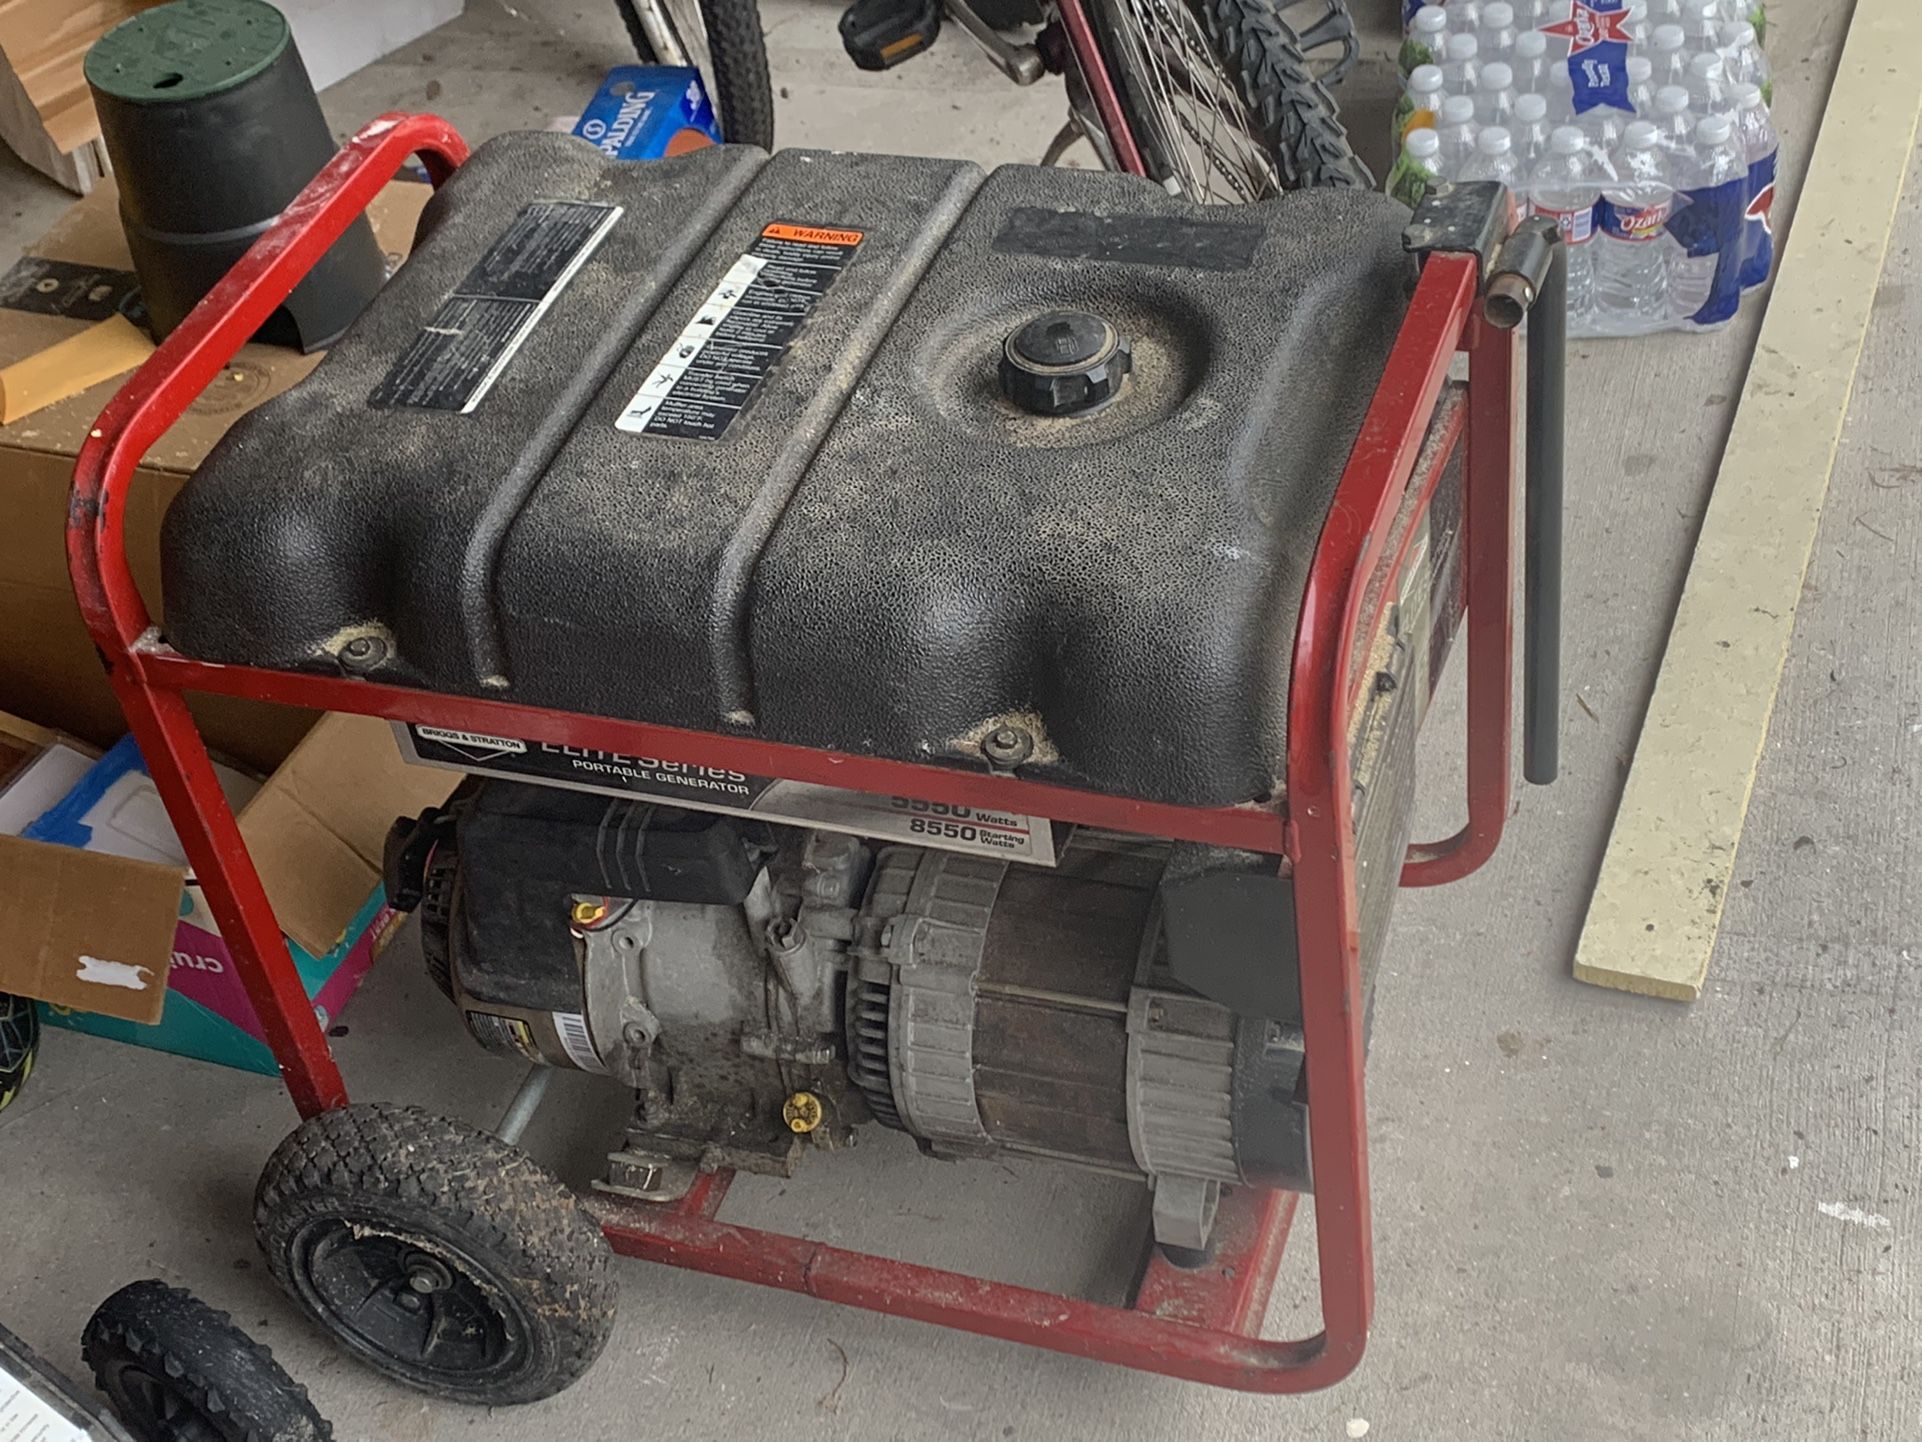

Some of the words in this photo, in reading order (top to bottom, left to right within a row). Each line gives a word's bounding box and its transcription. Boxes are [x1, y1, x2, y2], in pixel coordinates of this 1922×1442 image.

[794, 229, 858, 242] WARNING
[422, 728, 459, 740] BRIGGS
[471, 736, 521, 749] STRATTON
[572, 759, 651, 780] PORTABLE
[656, 772, 750, 795] GENERATOR
[976, 812, 1018, 827] Watts
[910, 818, 976, 841] 8550
[980, 829, 1025, 845] Starting
[981, 836, 1015, 848] Watts
